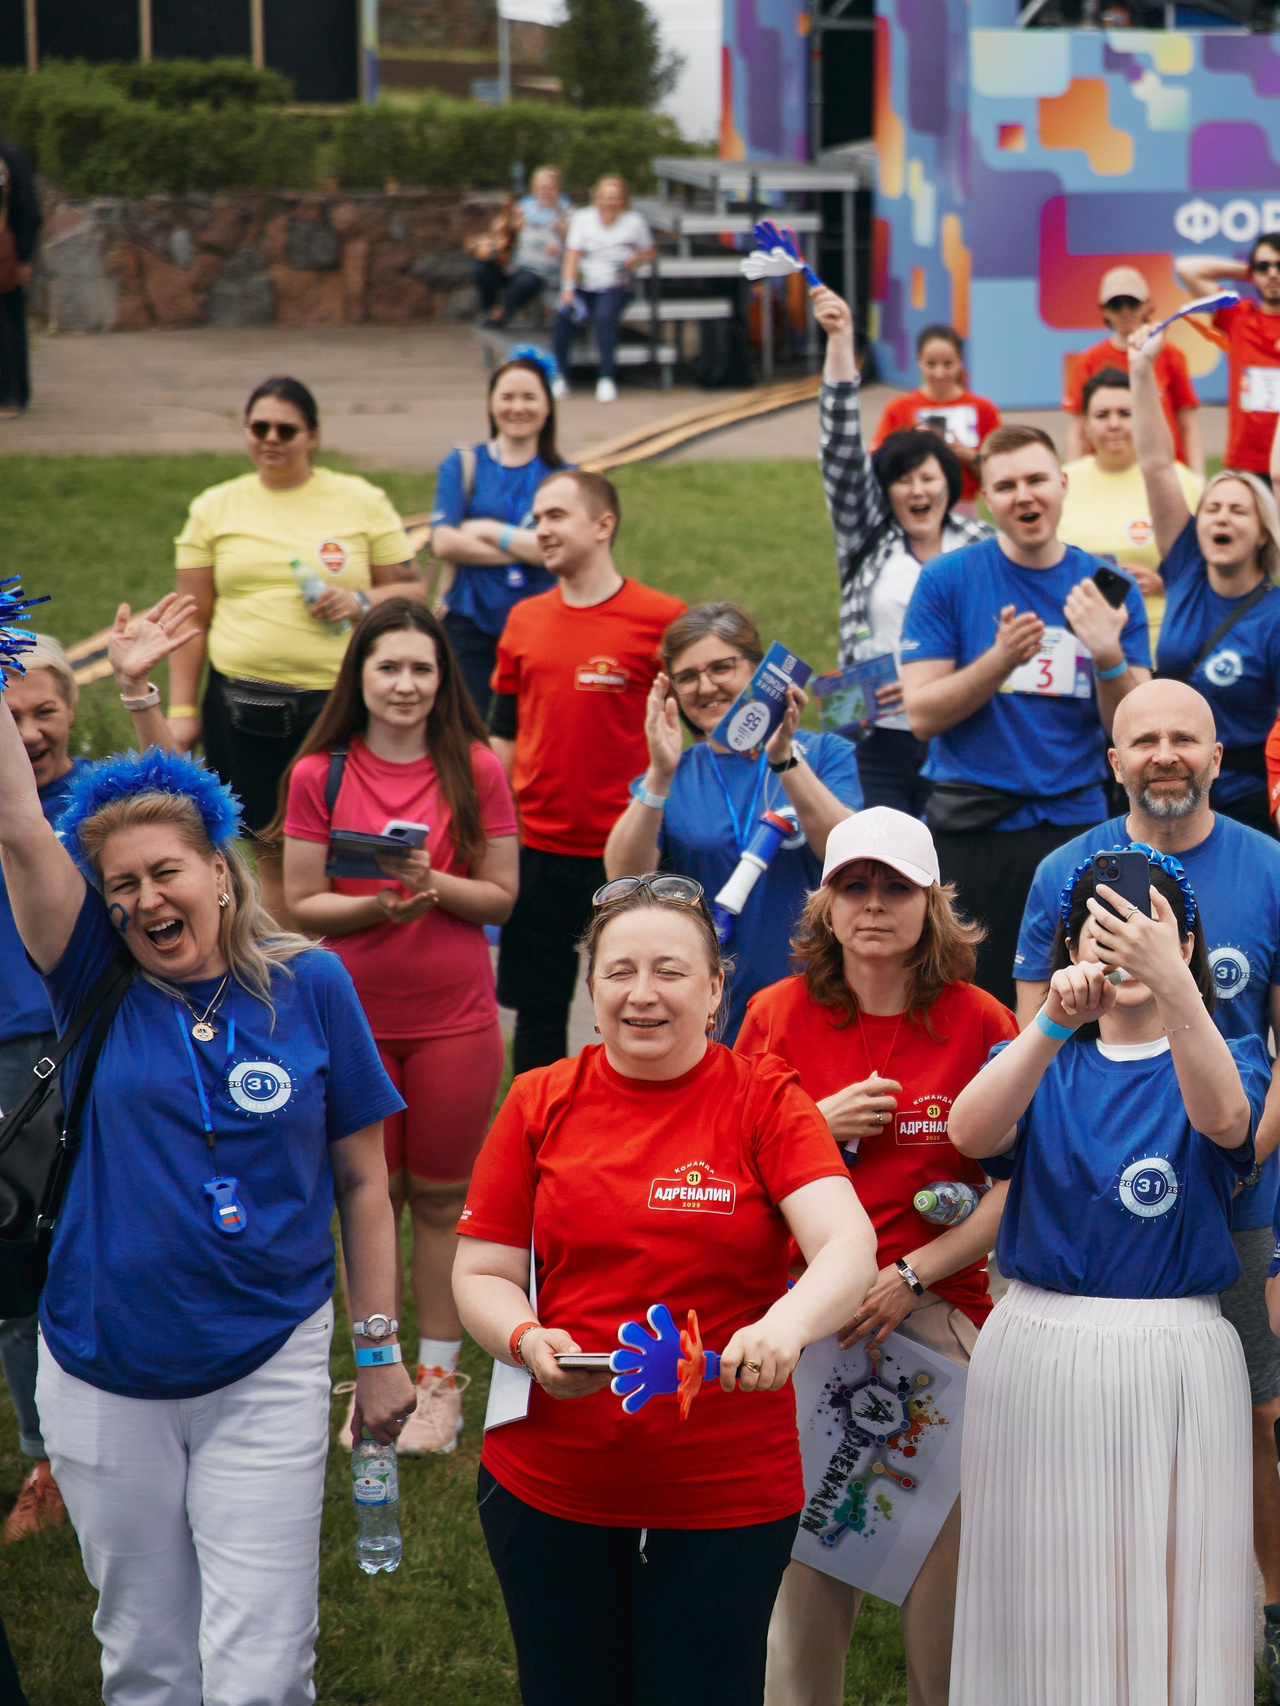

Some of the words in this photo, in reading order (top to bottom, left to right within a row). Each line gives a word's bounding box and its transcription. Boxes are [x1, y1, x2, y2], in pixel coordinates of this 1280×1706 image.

[1036, 659, 1053, 690] 3
[742, 712, 762, 732] 55
[1216, 967, 1237, 980] 31
[247, 1077, 273, 1091] 31
[912, 1094, 953, 1106] КОМАНДА
[929, 1107, 938, 1116] 31
[900, 1121, 948, 1135] АДРЕНАЛ
[674, 1161, 715, 1174] КОМАНДА
[688, 1173, 699, 1182] 31
[1136, 1178, 1161, 1195] 31
[654, 1186, 731, 1203] АДРЕНАЛИН
[1127, 1199, 1166, 1215] СИНИЙ
